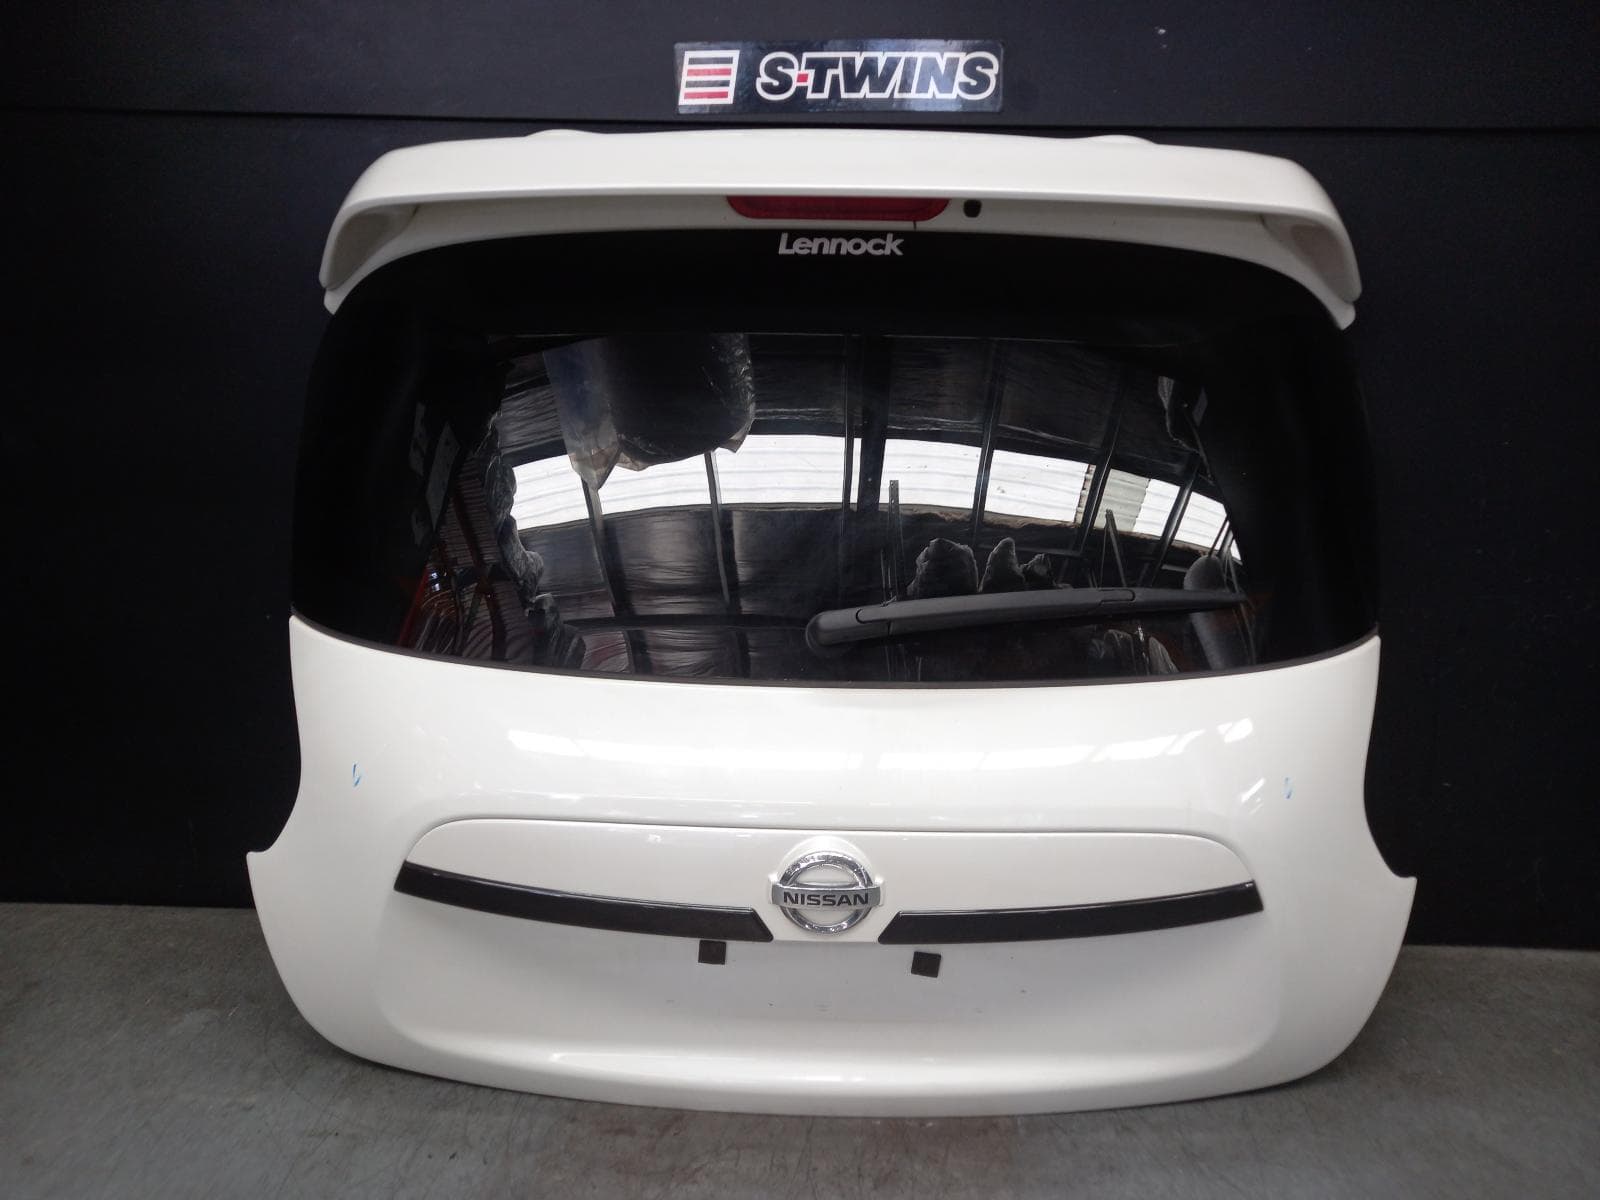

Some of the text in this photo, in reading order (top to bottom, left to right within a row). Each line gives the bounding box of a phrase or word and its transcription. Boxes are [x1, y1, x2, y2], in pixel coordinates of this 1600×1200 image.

[756, 51, 999, 101] S-TWINS
[778, 233, 904, 256] Lennock
[783, 891, 869, 906] NISSAN
